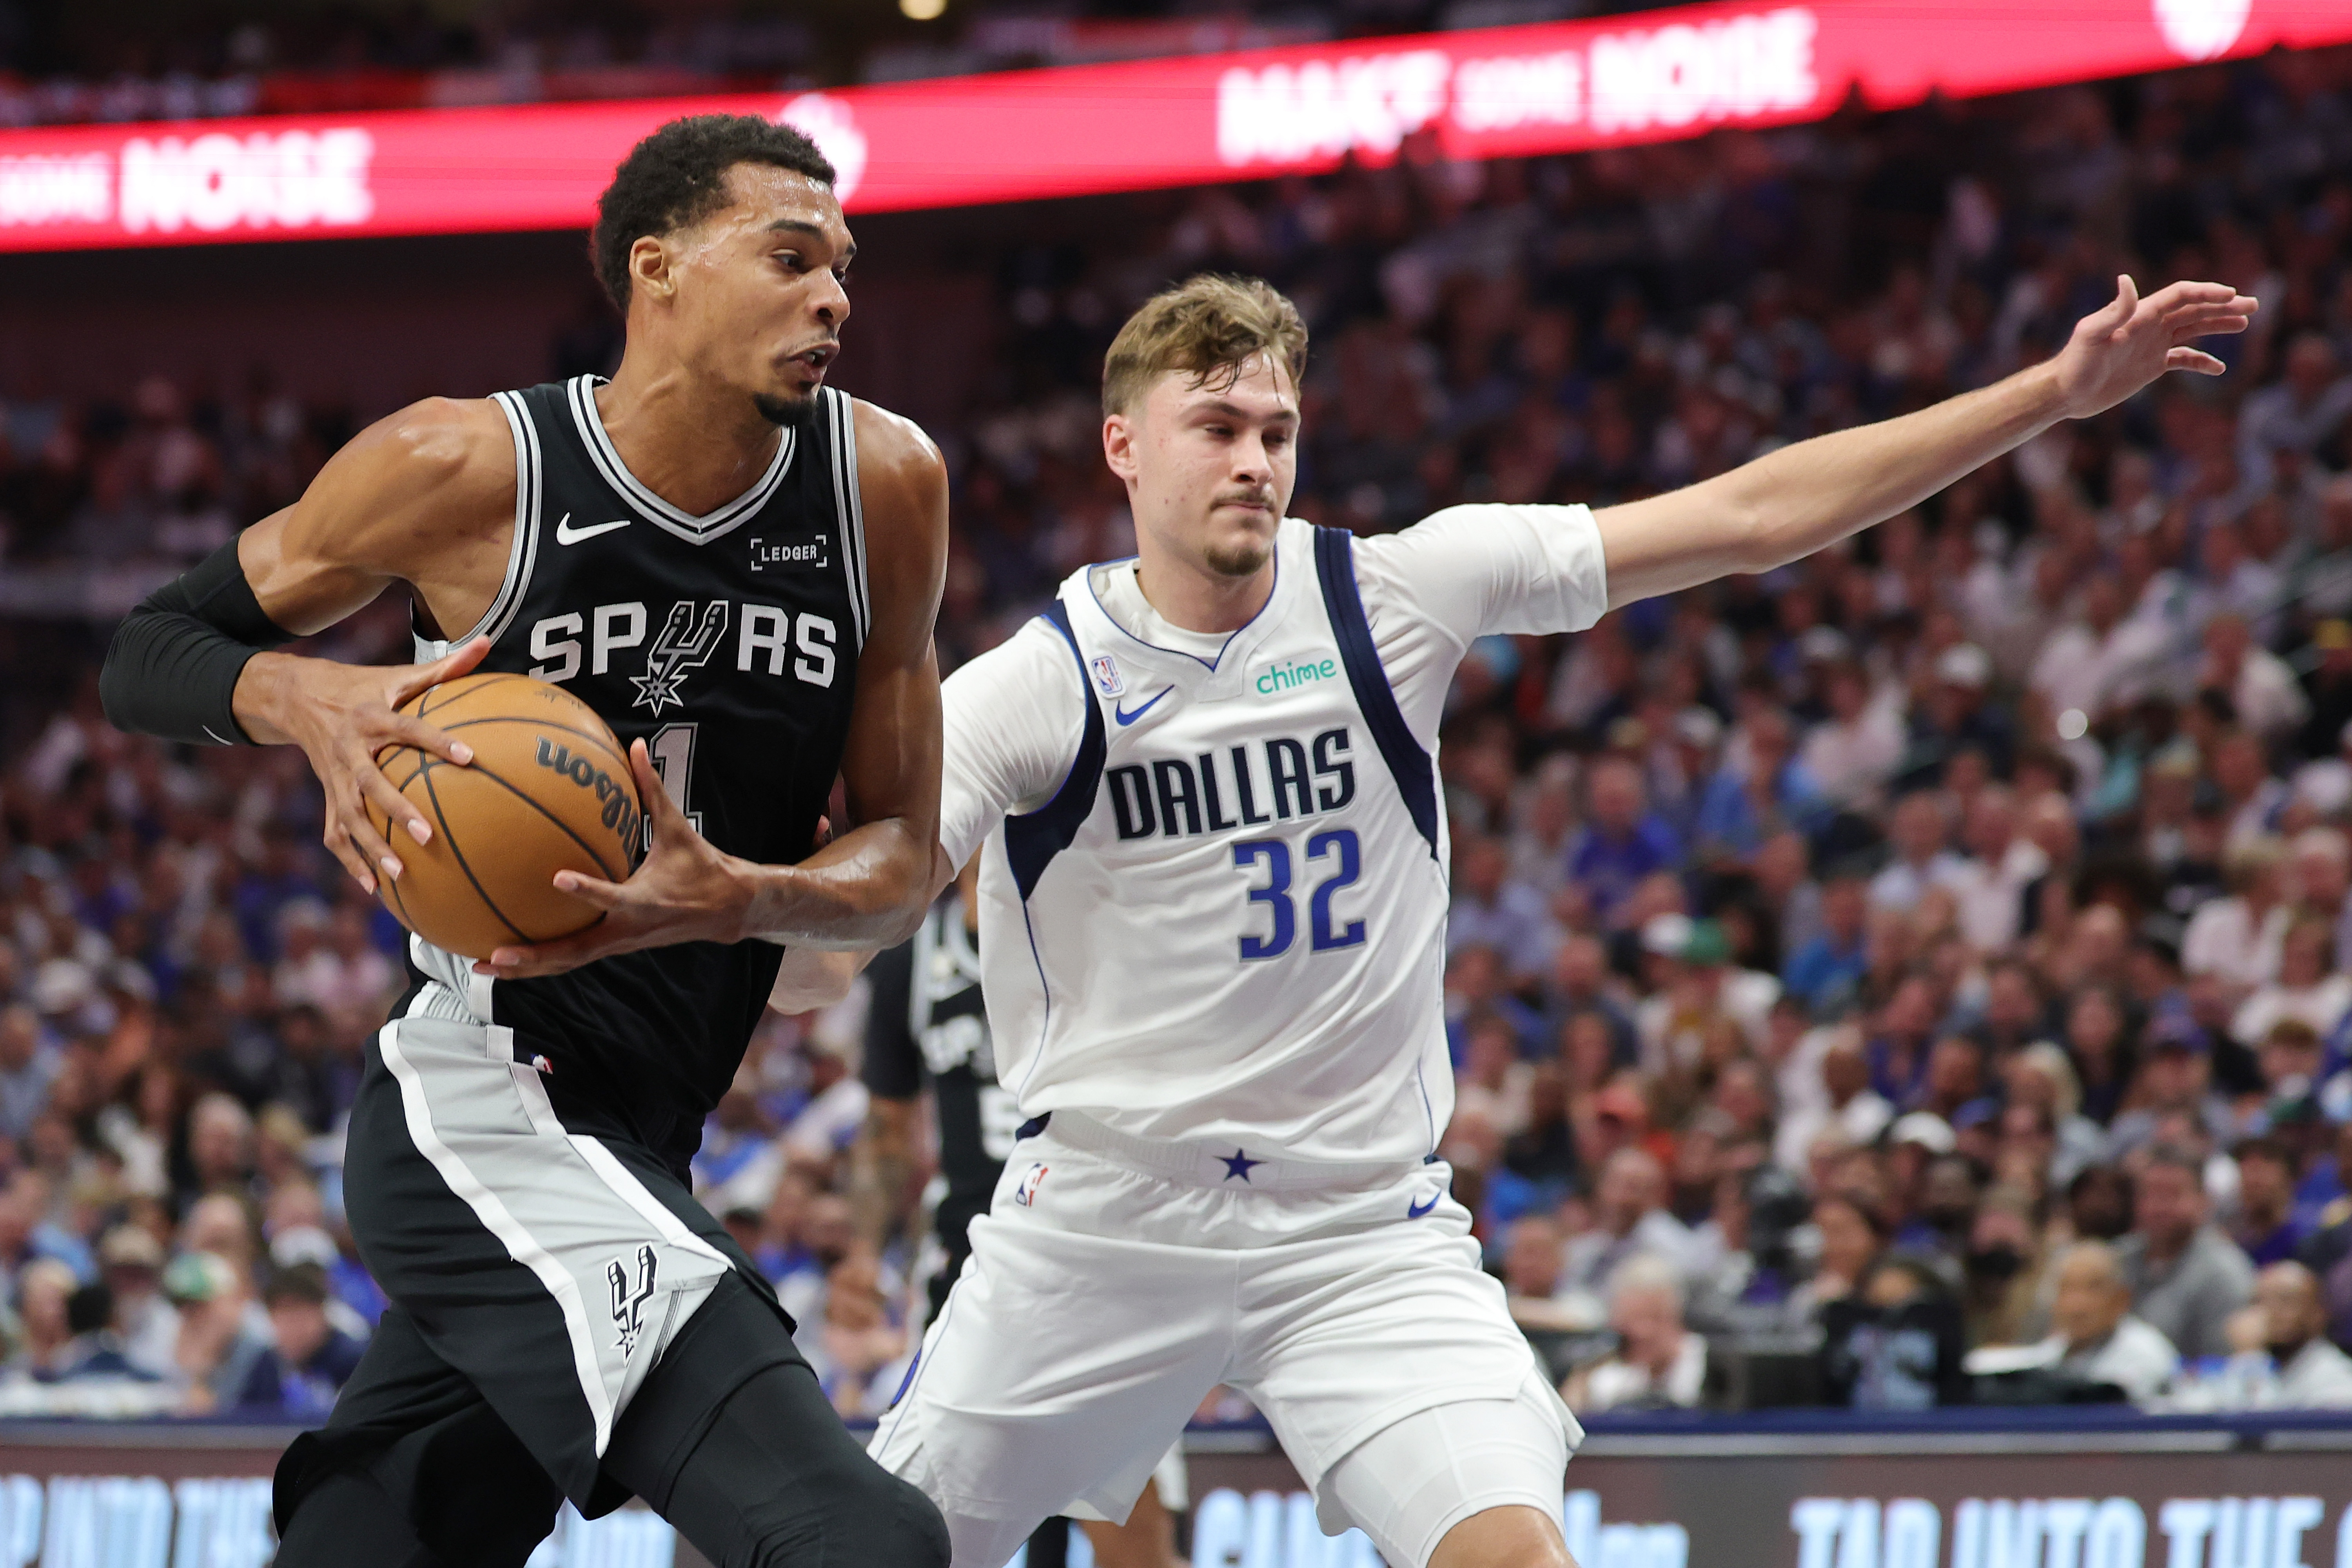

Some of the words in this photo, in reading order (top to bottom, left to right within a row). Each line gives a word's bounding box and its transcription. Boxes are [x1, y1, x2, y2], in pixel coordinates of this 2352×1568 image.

[1588, 8, 1819, 134] NOISE
[120, 127, 375, 234] NOISE
[761, 544, 817, 562] LEDGER
[529, 600, 837, 717] SPURS
[1256, 660, 1336, 694] chime
[644, 722, 702, 852] 1
[1106, 728, 1356, 840] DALLAS
[1231, 829, 1367, 963] 32
